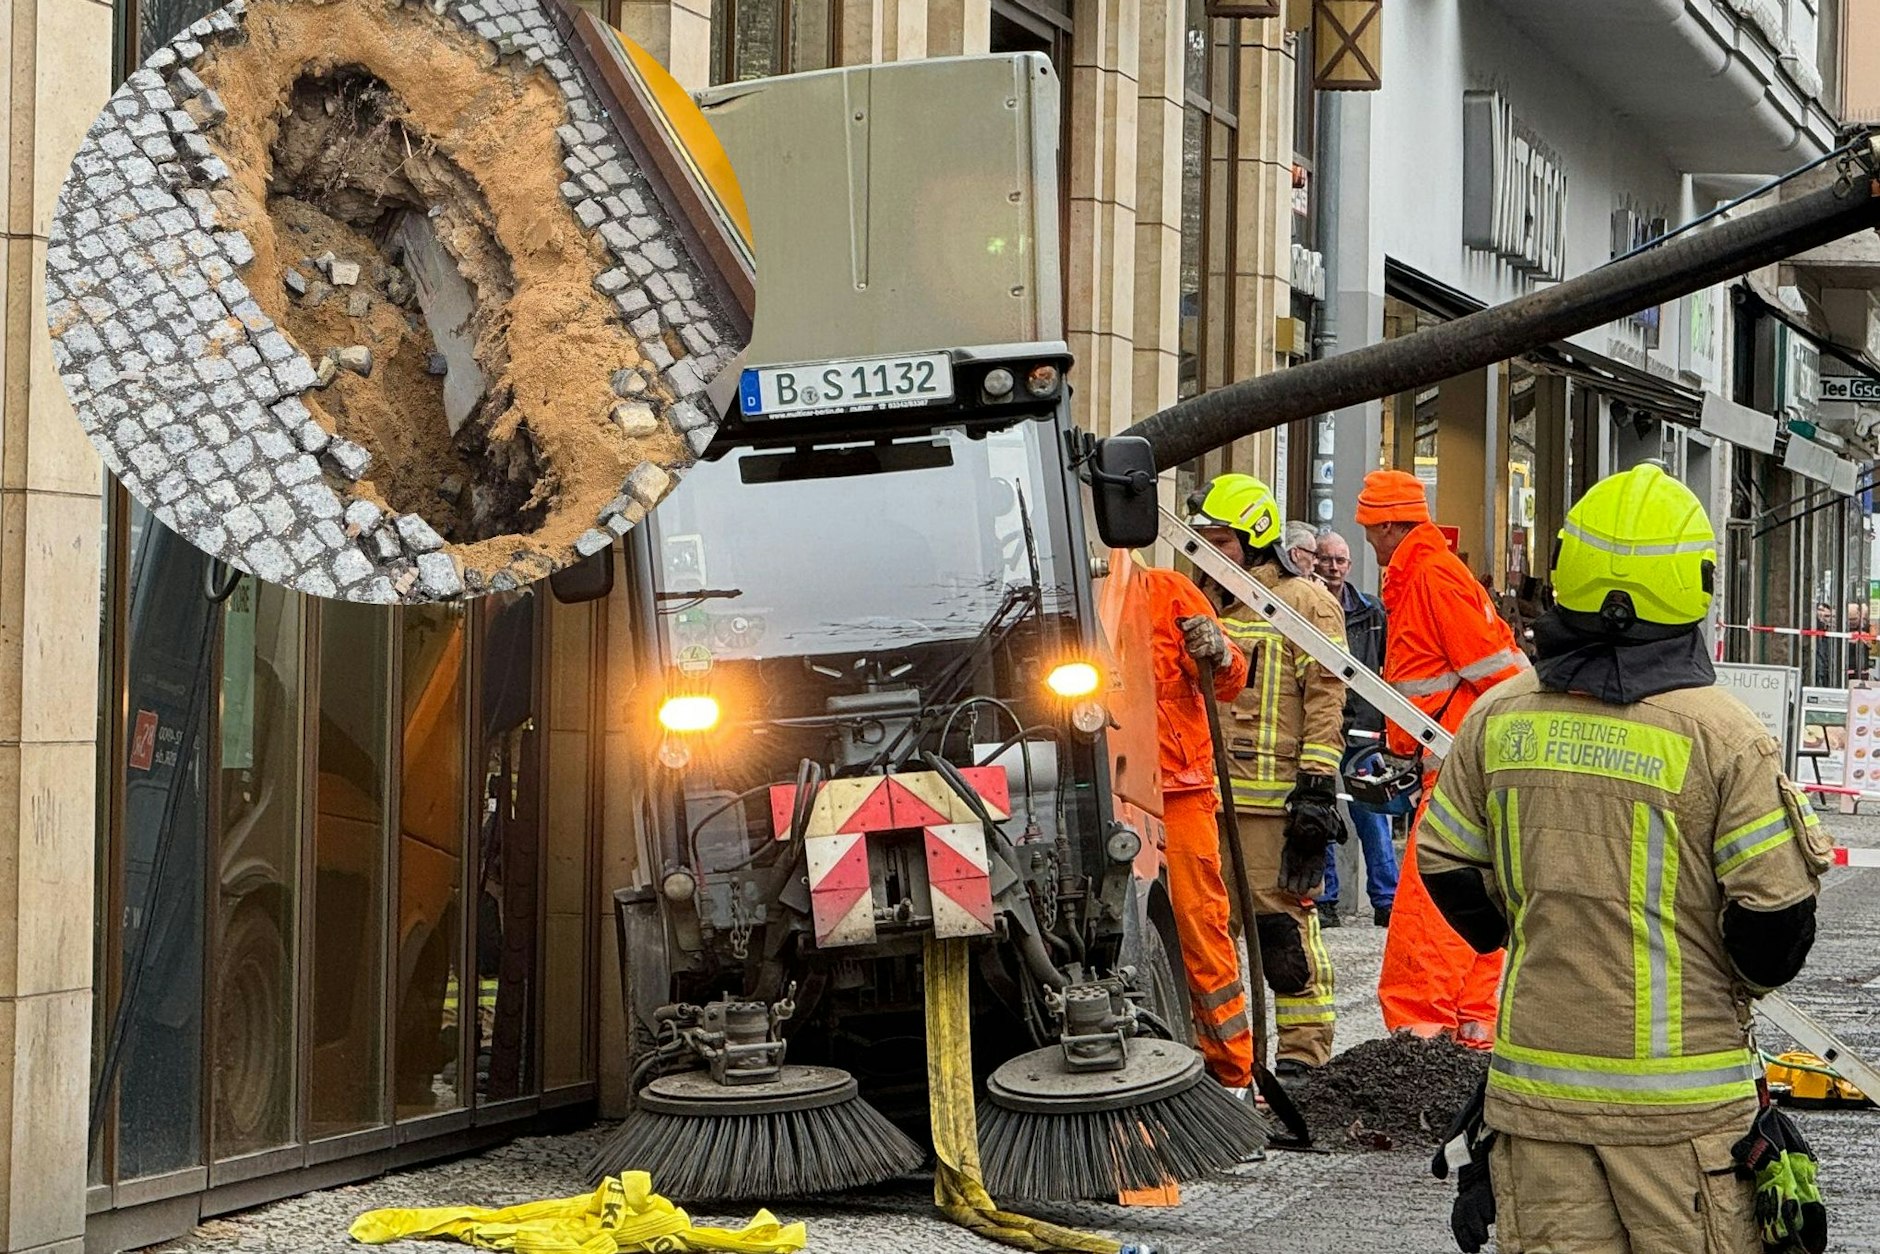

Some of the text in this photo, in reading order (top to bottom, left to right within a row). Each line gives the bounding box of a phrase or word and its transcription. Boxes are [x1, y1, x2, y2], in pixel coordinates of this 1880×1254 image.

[776, 373, 798, 405] B
[851, 360, 937, 398] 1132
[1820, 380, 1848, 396] Tee
[747, 396, 756, 407] D
[1549, 720, 1629, 746] BERLINER
[1544, 741, 1665, 781] FEUERWEHR
